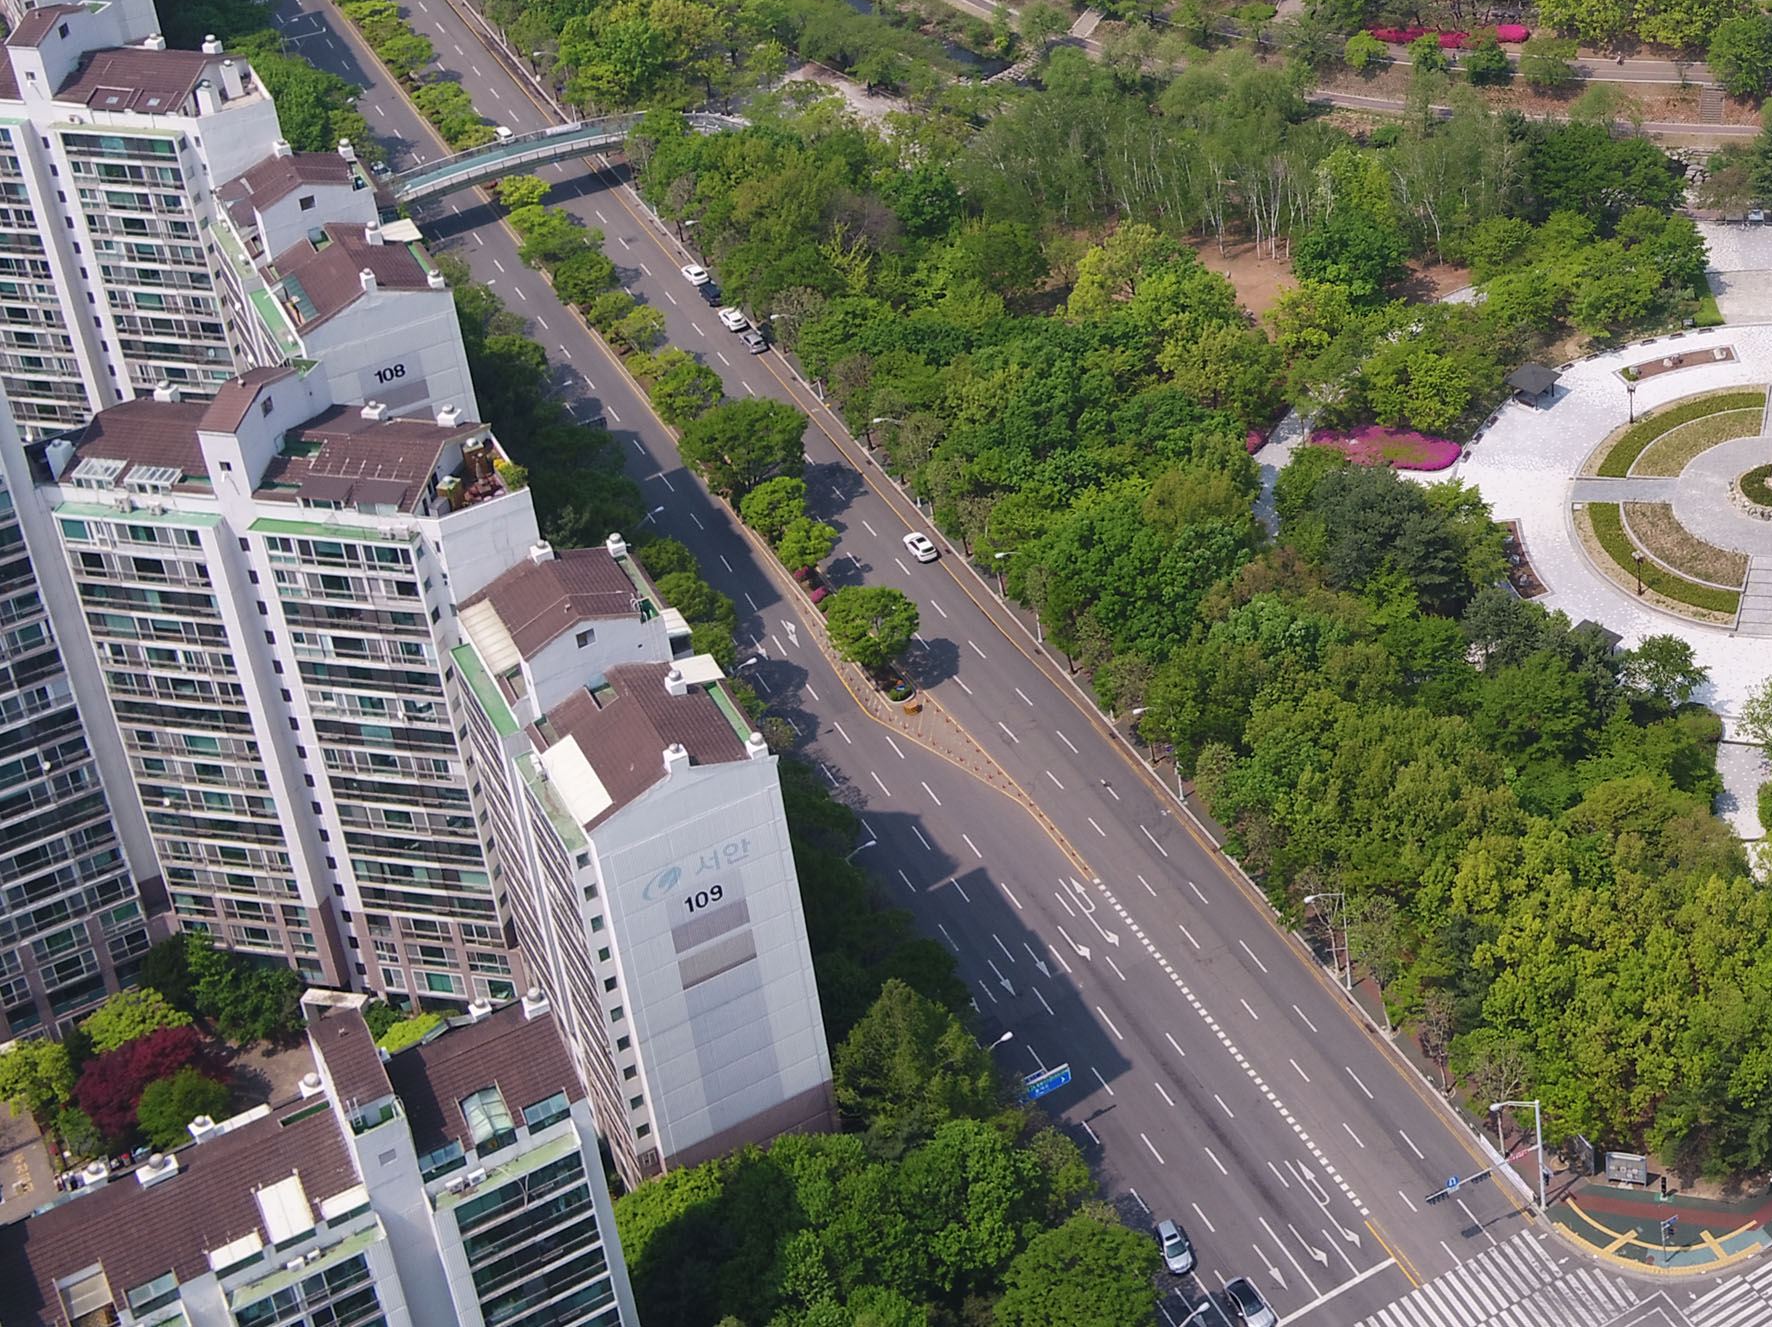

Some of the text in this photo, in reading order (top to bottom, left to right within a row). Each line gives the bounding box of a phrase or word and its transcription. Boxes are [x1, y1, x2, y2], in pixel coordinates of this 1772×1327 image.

[374, 363, 406, 384] 108
[696, 838, 751, 876] 서안
[684, 884, 723, 912] 109
